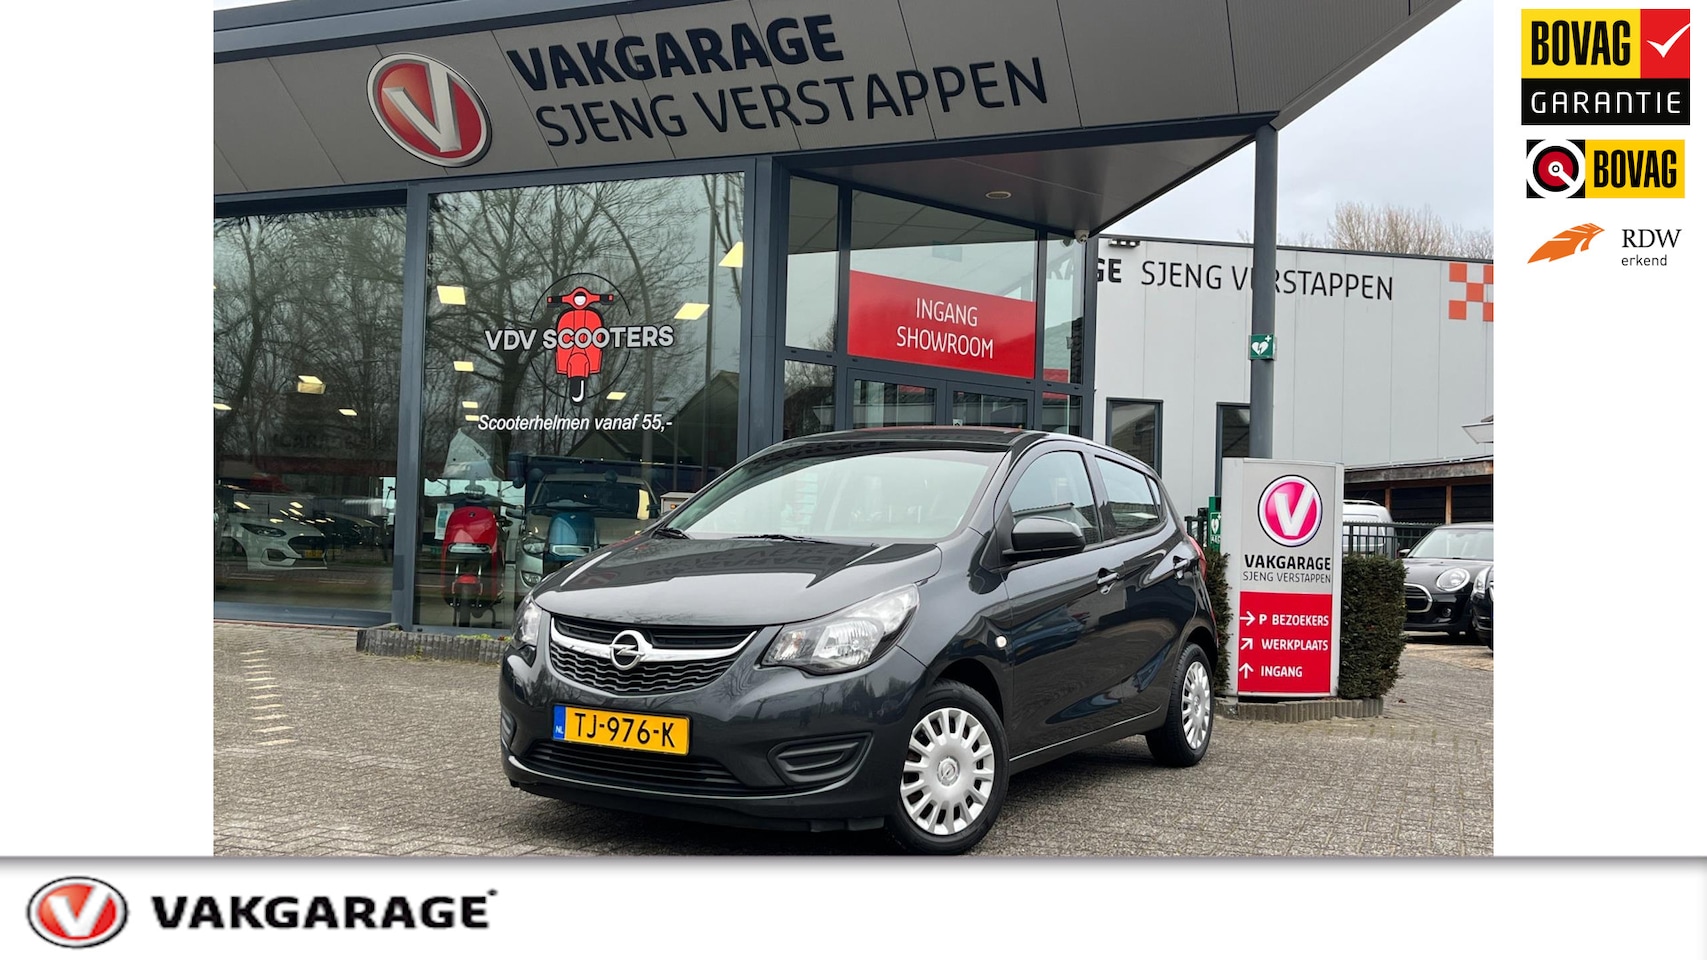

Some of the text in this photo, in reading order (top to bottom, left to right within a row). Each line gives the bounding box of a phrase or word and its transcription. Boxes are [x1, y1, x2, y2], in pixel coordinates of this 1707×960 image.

[506, 14, 844, 92] VAKGARAGE
[535, 56, 1049, 147] SJENG VERSTAPPEN
[1141, 260, 1222, 290] SJENG
[1231, 265, 1393, 301] VSTAPPEN
[916, 298, 978, 327] INGANG
[484, 325, 674, 351] VDV SCOOTERS
[896, 326, 993, 359] SHOWROOM
[478, 413, 673, 432] Scooterhelmen vanaf 55,-
[1244, 554, 1331, 571] VAKGARAGE
[1242, 571, 1331, 584] SJENG VERSTAPPEN
[1259, 613, 1329, 627] P BEZOEKERS
[1261, 638, 1329, 651] WERKPLAATS
[1261, 665, 1303, 678] INGANG
[555, 712, 675, 748] NL TJ-976-K
